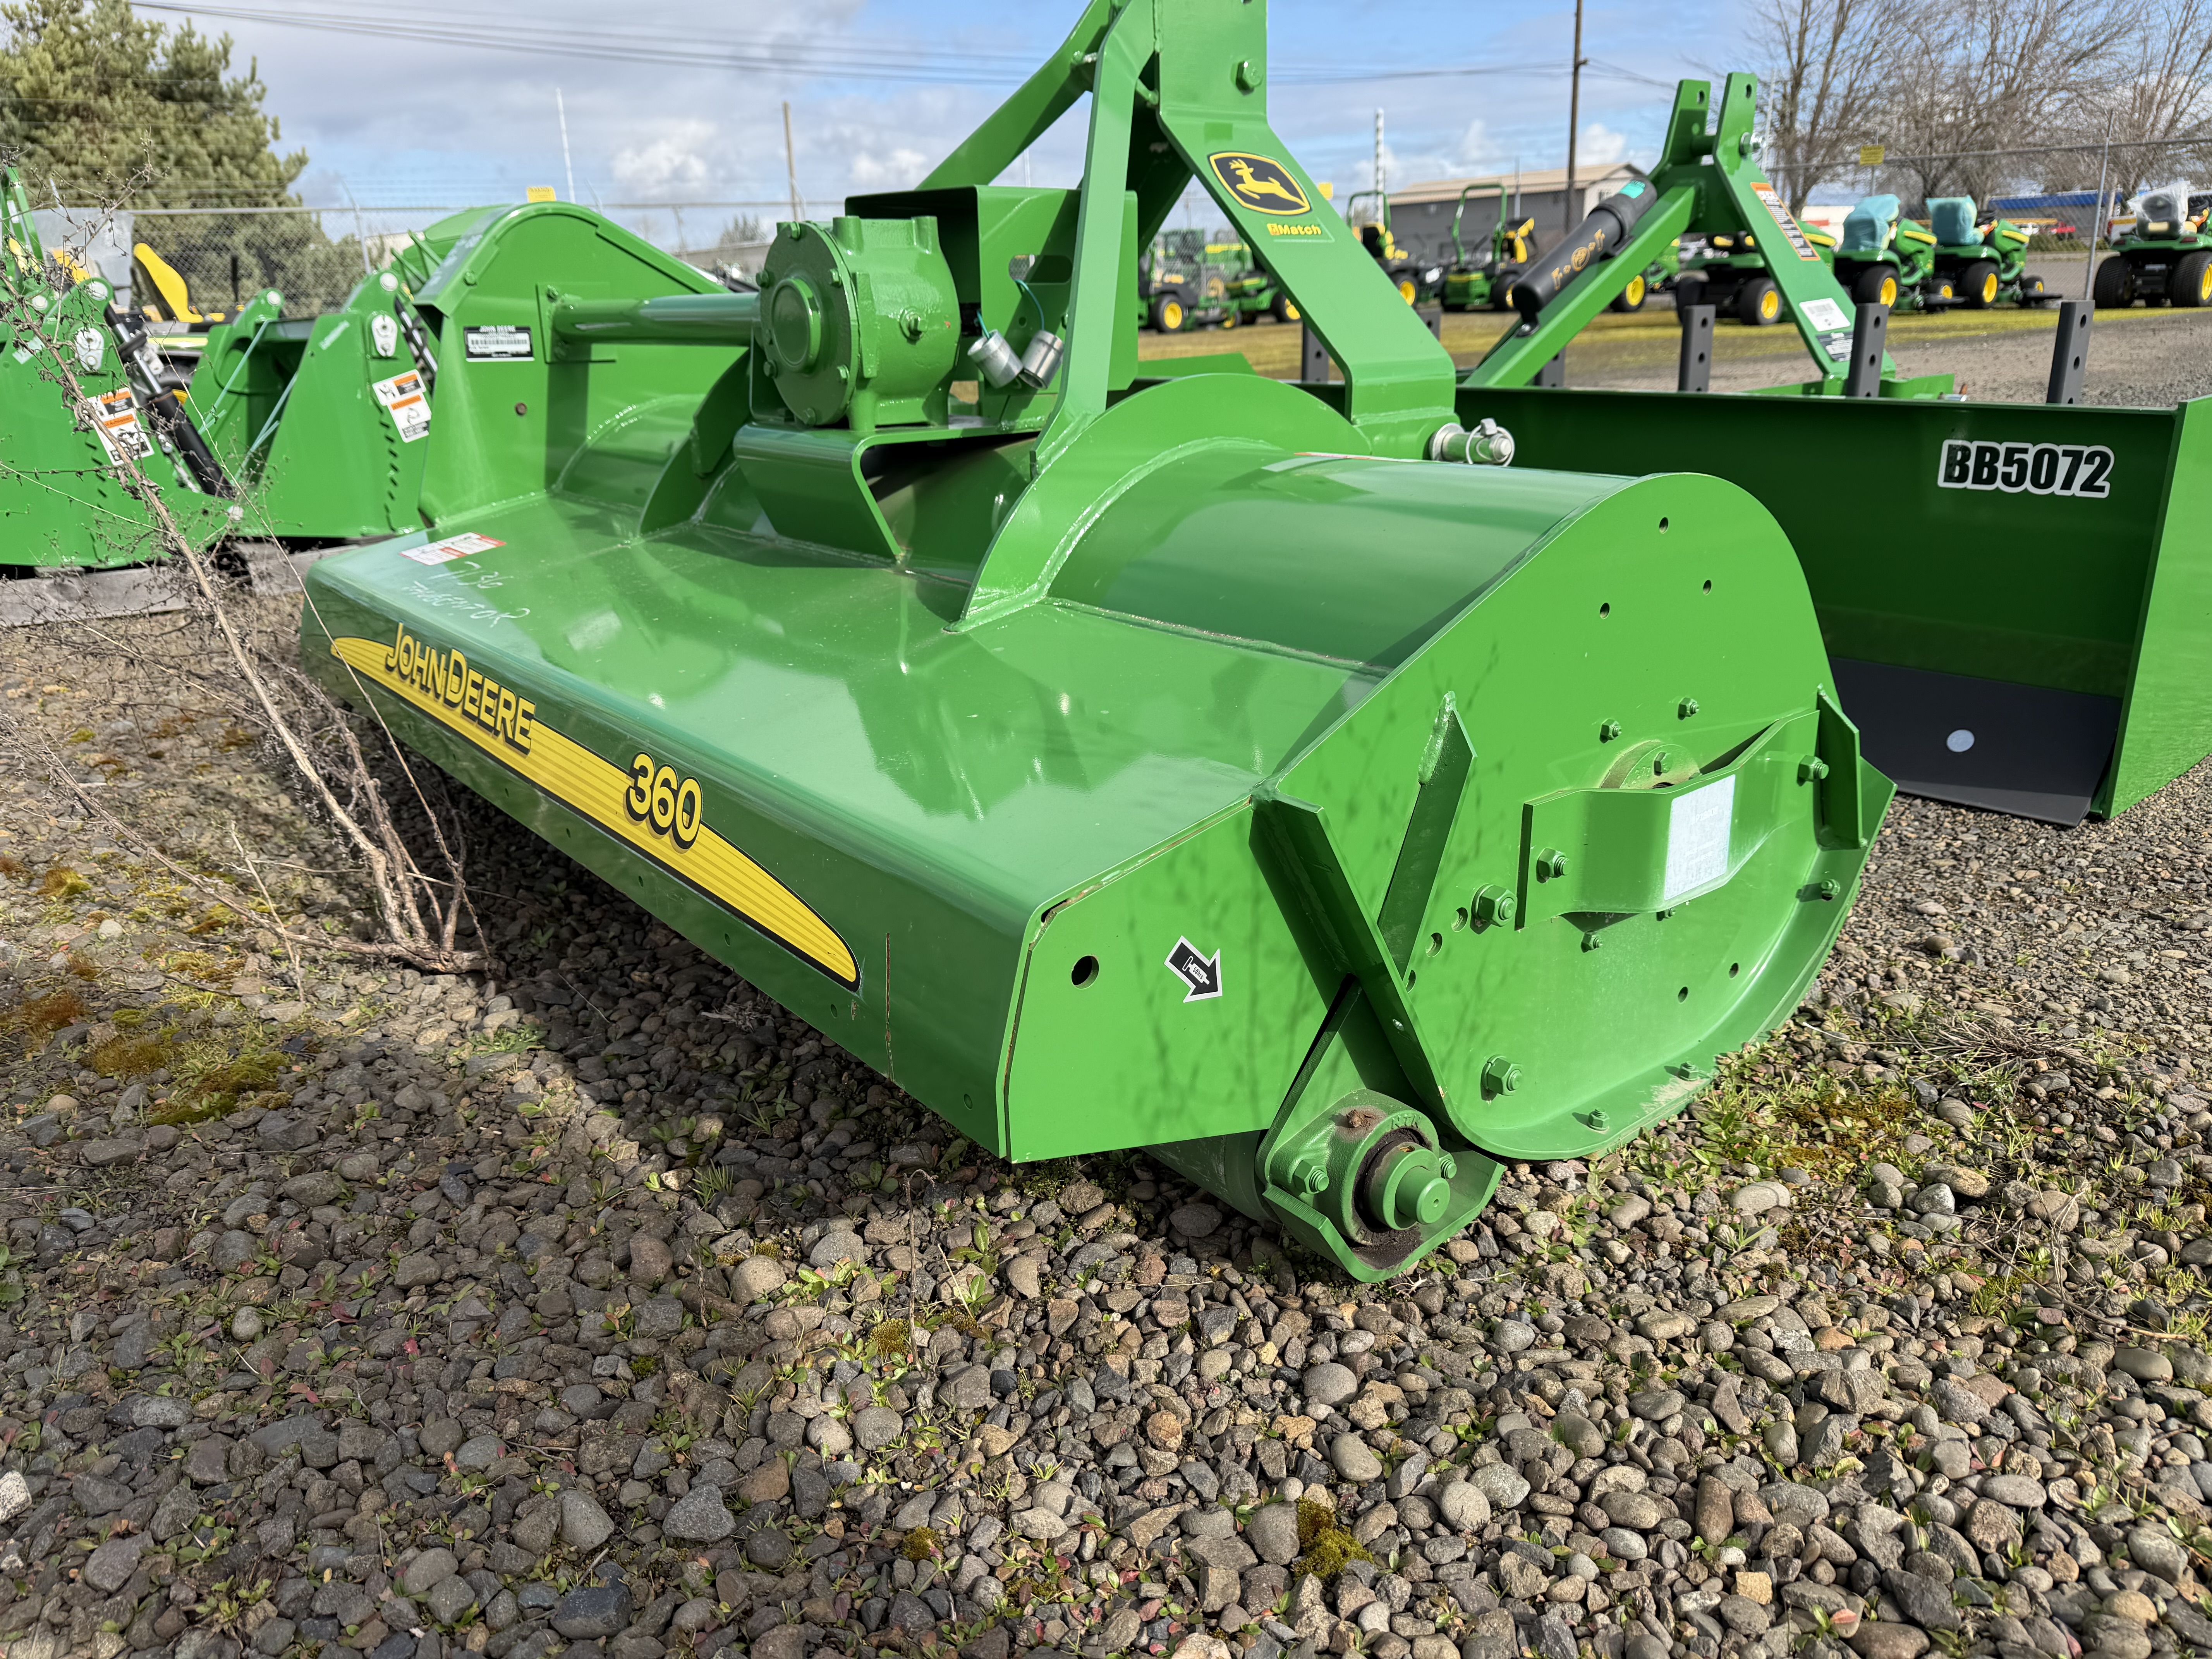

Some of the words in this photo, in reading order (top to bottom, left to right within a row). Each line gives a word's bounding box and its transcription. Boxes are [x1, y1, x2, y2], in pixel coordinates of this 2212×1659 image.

[1942, 444, 2112, 493] BB5072
[386, 622, 446, 700] JOHN
[443, 649, 536, 756] DEERE
[626, 752, 703, 849] 360
[1192, 967, 1203, 980] 50hrs
